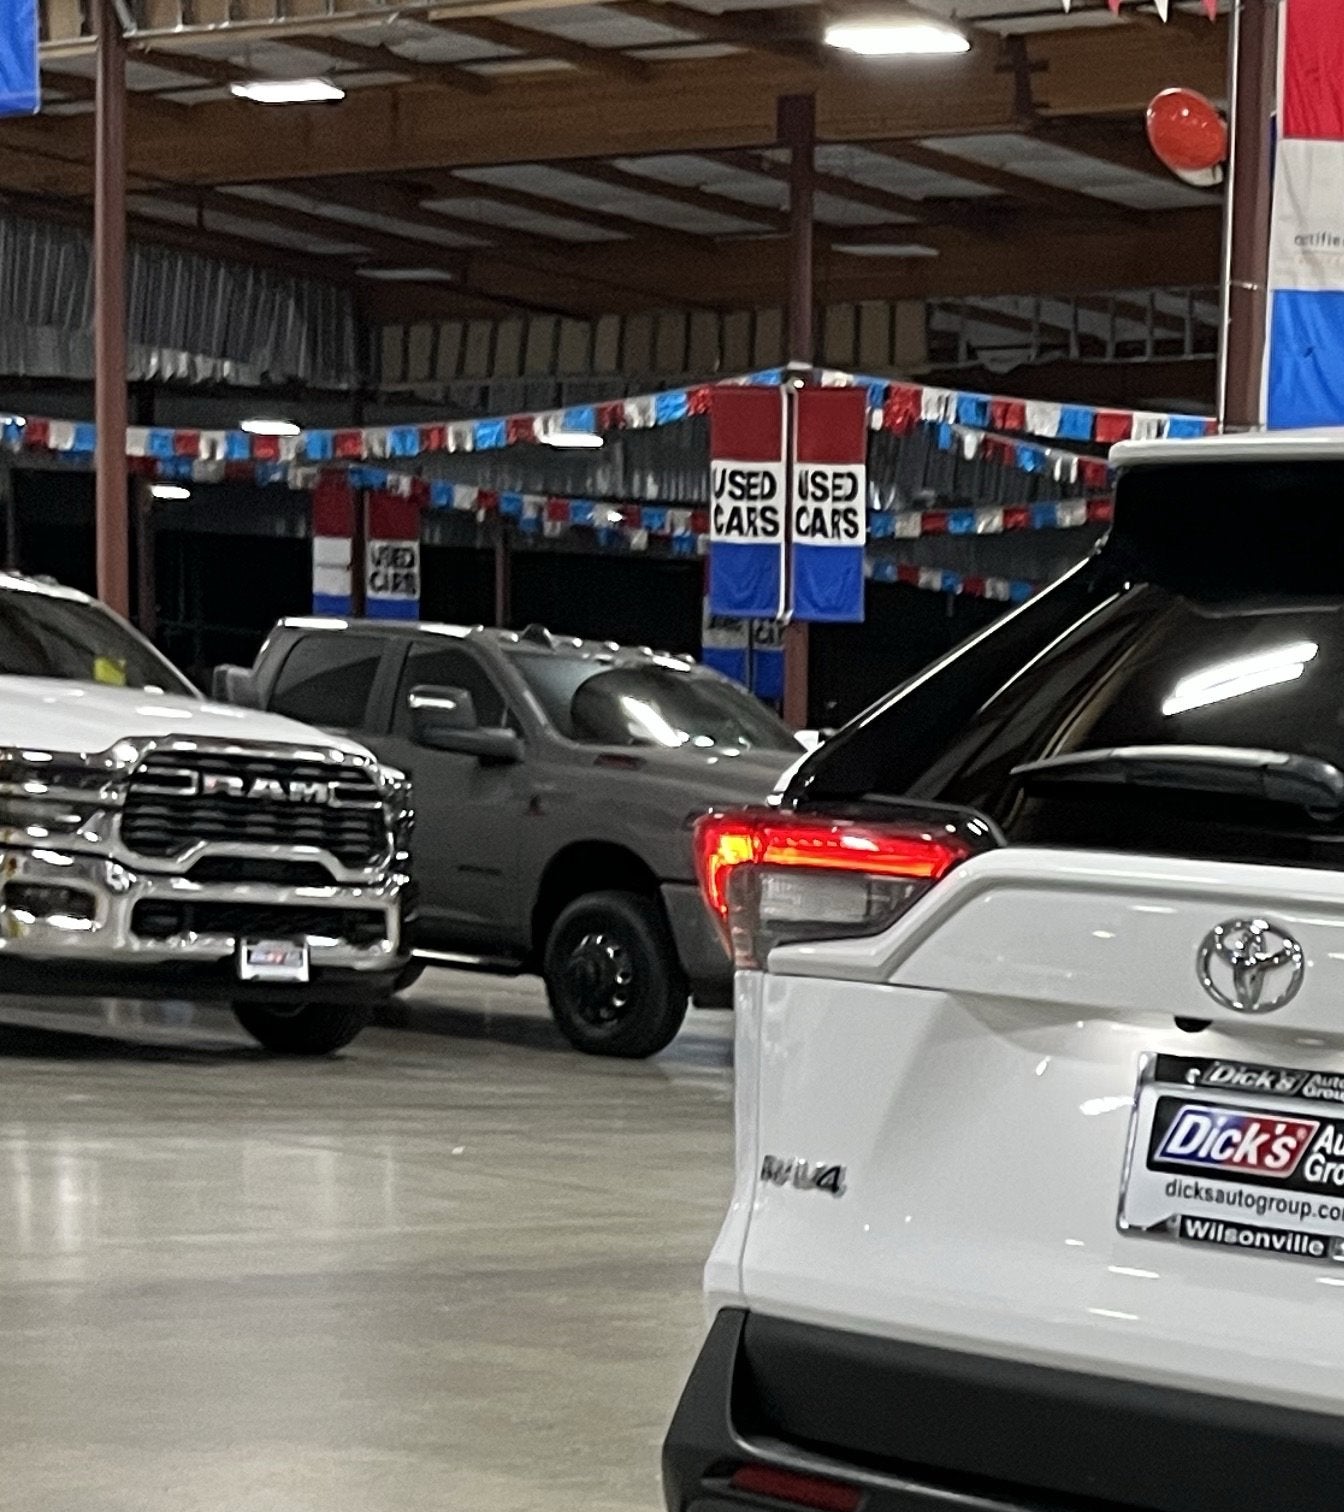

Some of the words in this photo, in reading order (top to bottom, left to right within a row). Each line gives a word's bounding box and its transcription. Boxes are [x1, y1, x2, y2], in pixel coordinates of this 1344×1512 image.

[713, 468, 777, 500] USED
[798, 470, 859, 502] USED
[713, 504, 780, 536] CARS
[796, 506, 859, 539] CARS
[202, 773, 328, 803] RAM
[1208, 1063, 1298, 1092] Dick's
[1165, 1113, 1298, 1169] Dick's
[1184, 1217, 1325, 1256] Wilsonville
